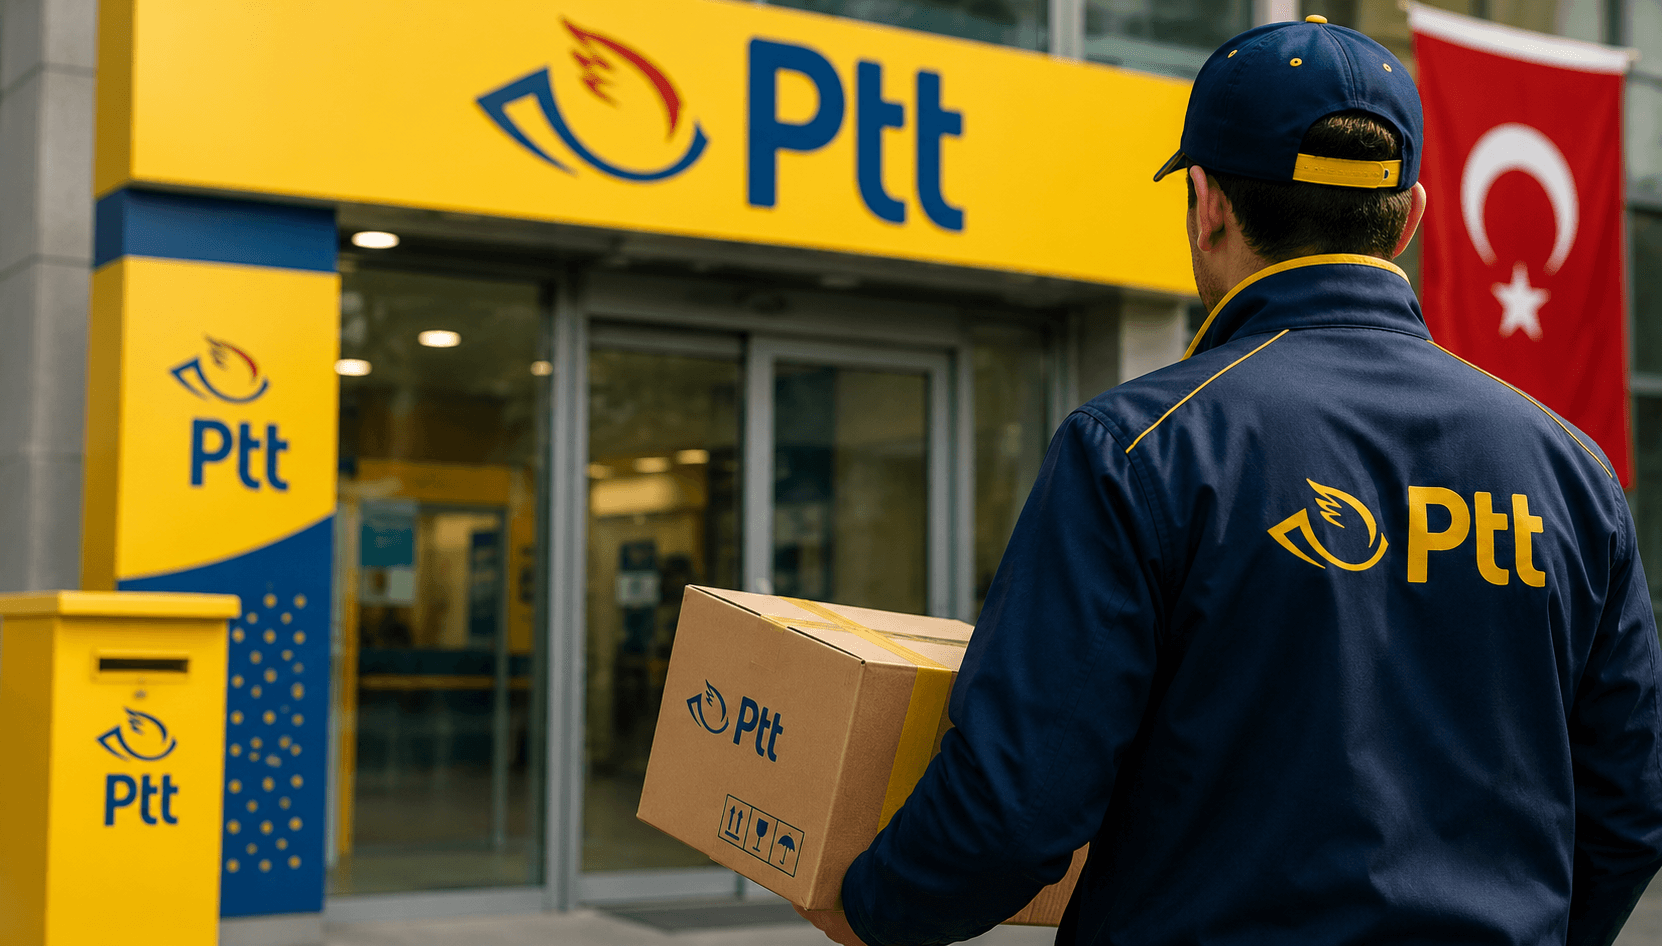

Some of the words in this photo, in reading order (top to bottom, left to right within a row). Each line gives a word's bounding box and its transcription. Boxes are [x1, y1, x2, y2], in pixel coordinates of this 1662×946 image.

[747, 38, 965, 232] Ptt
[190, 418, 289, 492] Ptt
[1407, 485, 1546, 587] Ptt
[732, 695, 785, 763] Ptt
[104, 773, 179, 827] Ptt
